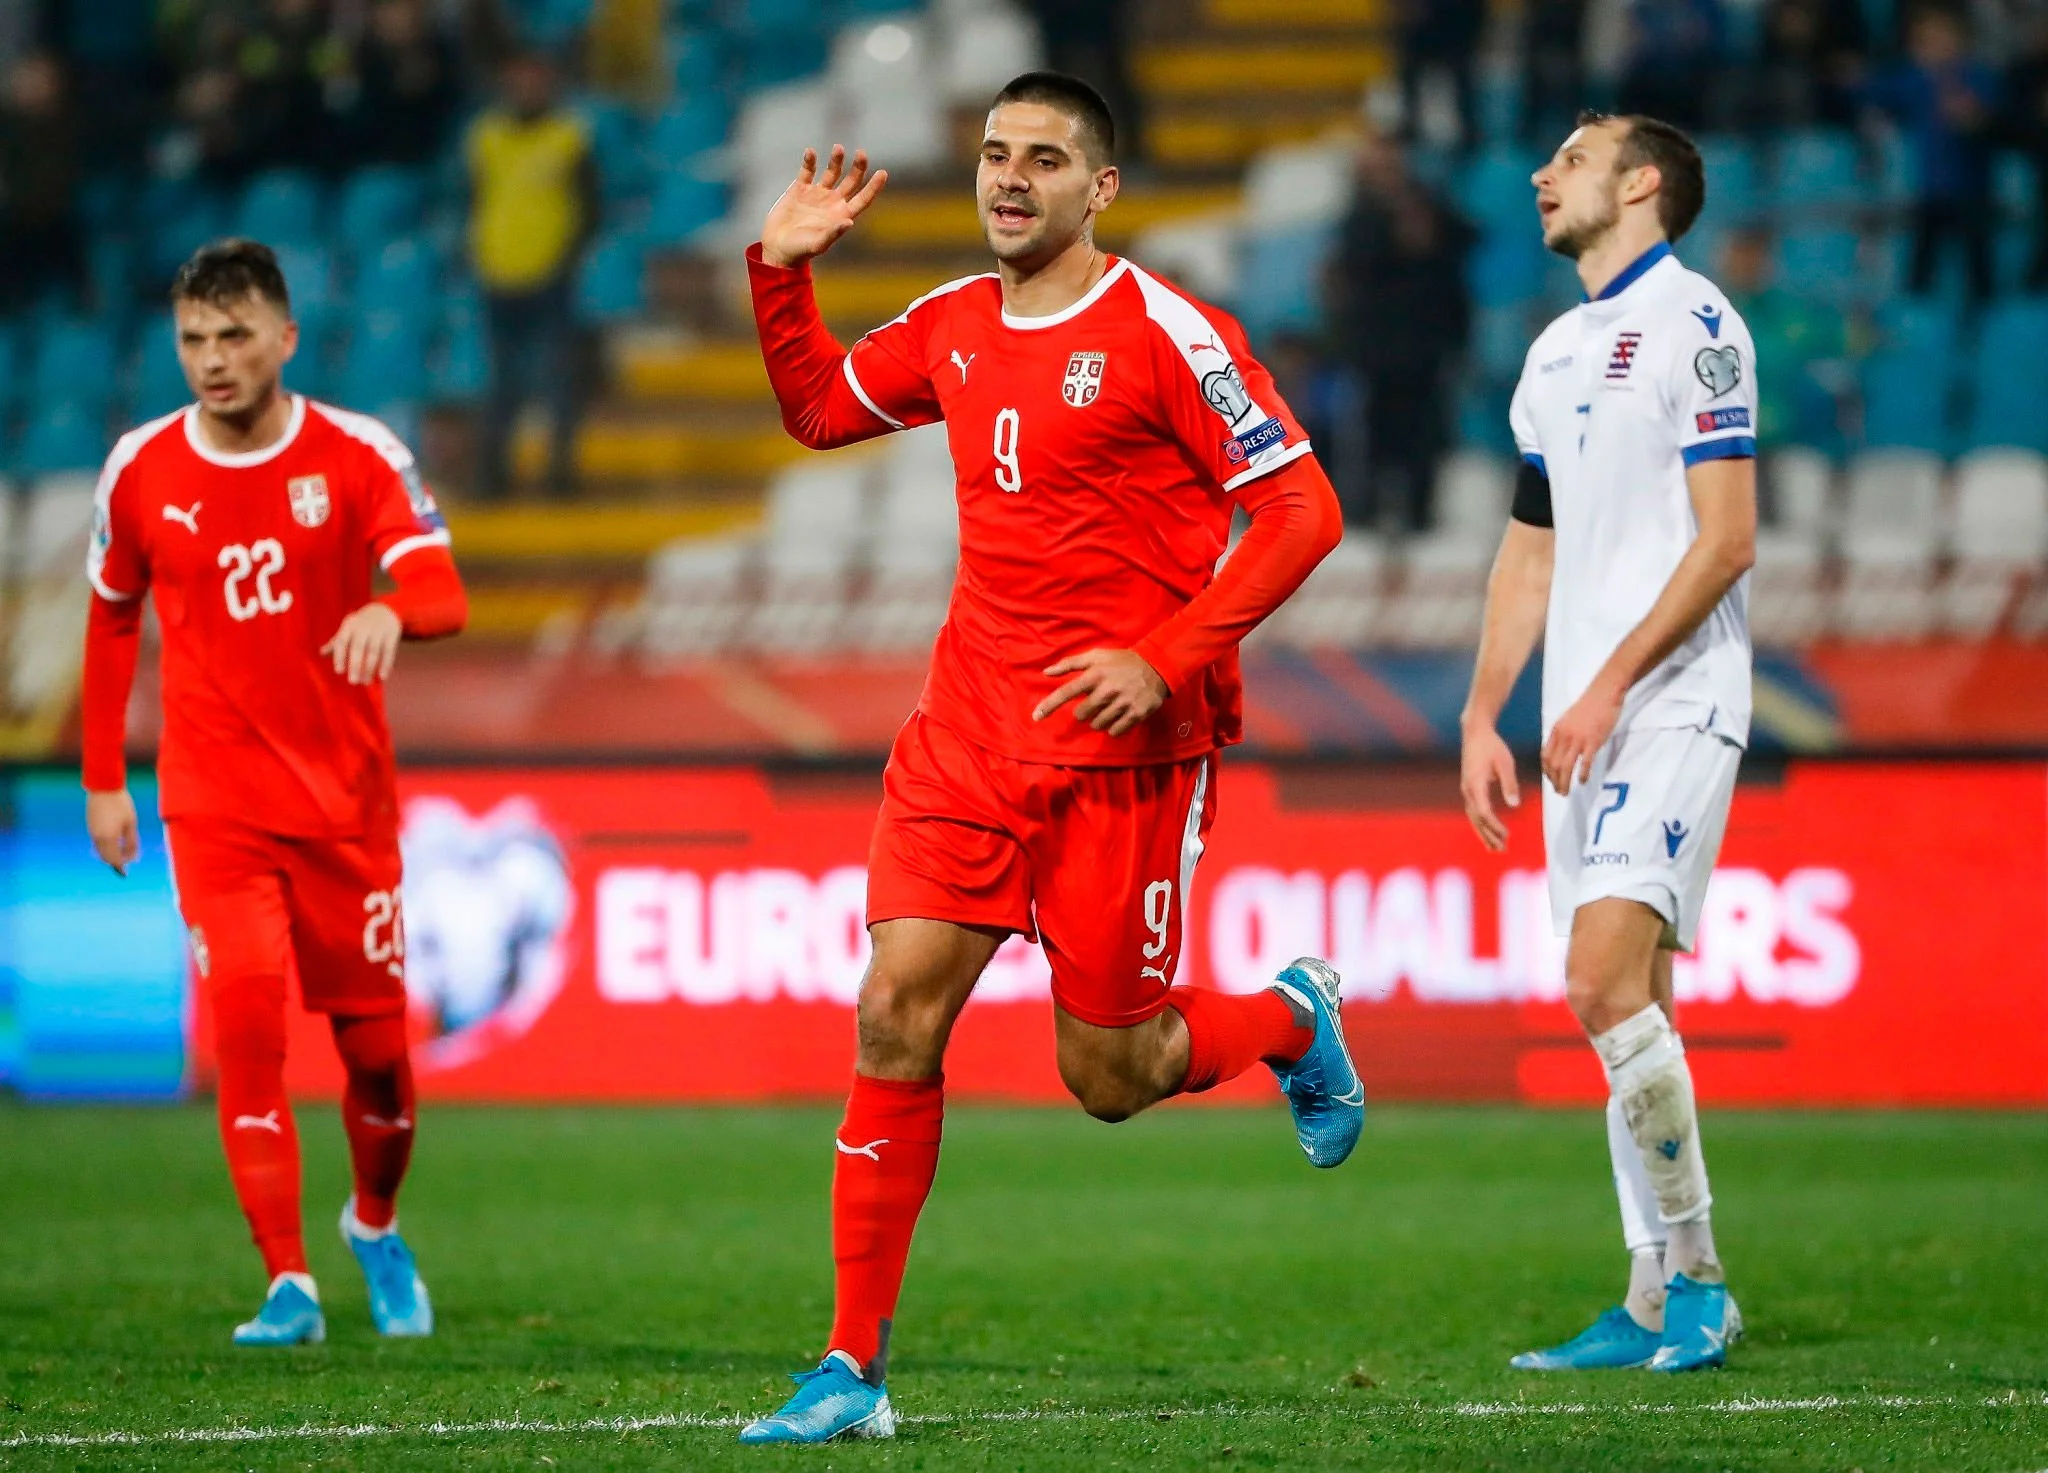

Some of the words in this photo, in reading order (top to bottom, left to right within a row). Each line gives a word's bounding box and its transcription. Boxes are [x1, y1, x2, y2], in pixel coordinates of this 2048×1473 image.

[993, 407, 1022, 493] 9
[1242, 421, 1284, 451] RESPECT
[217, 537, 294, 622] 22
[1593, 783, 1629, 845] 7
[1581, 852, 1630, 867] acron
[1142, 879, 1172, 960] 9
[1208, 866, 1861, 1006] QUALIRS
